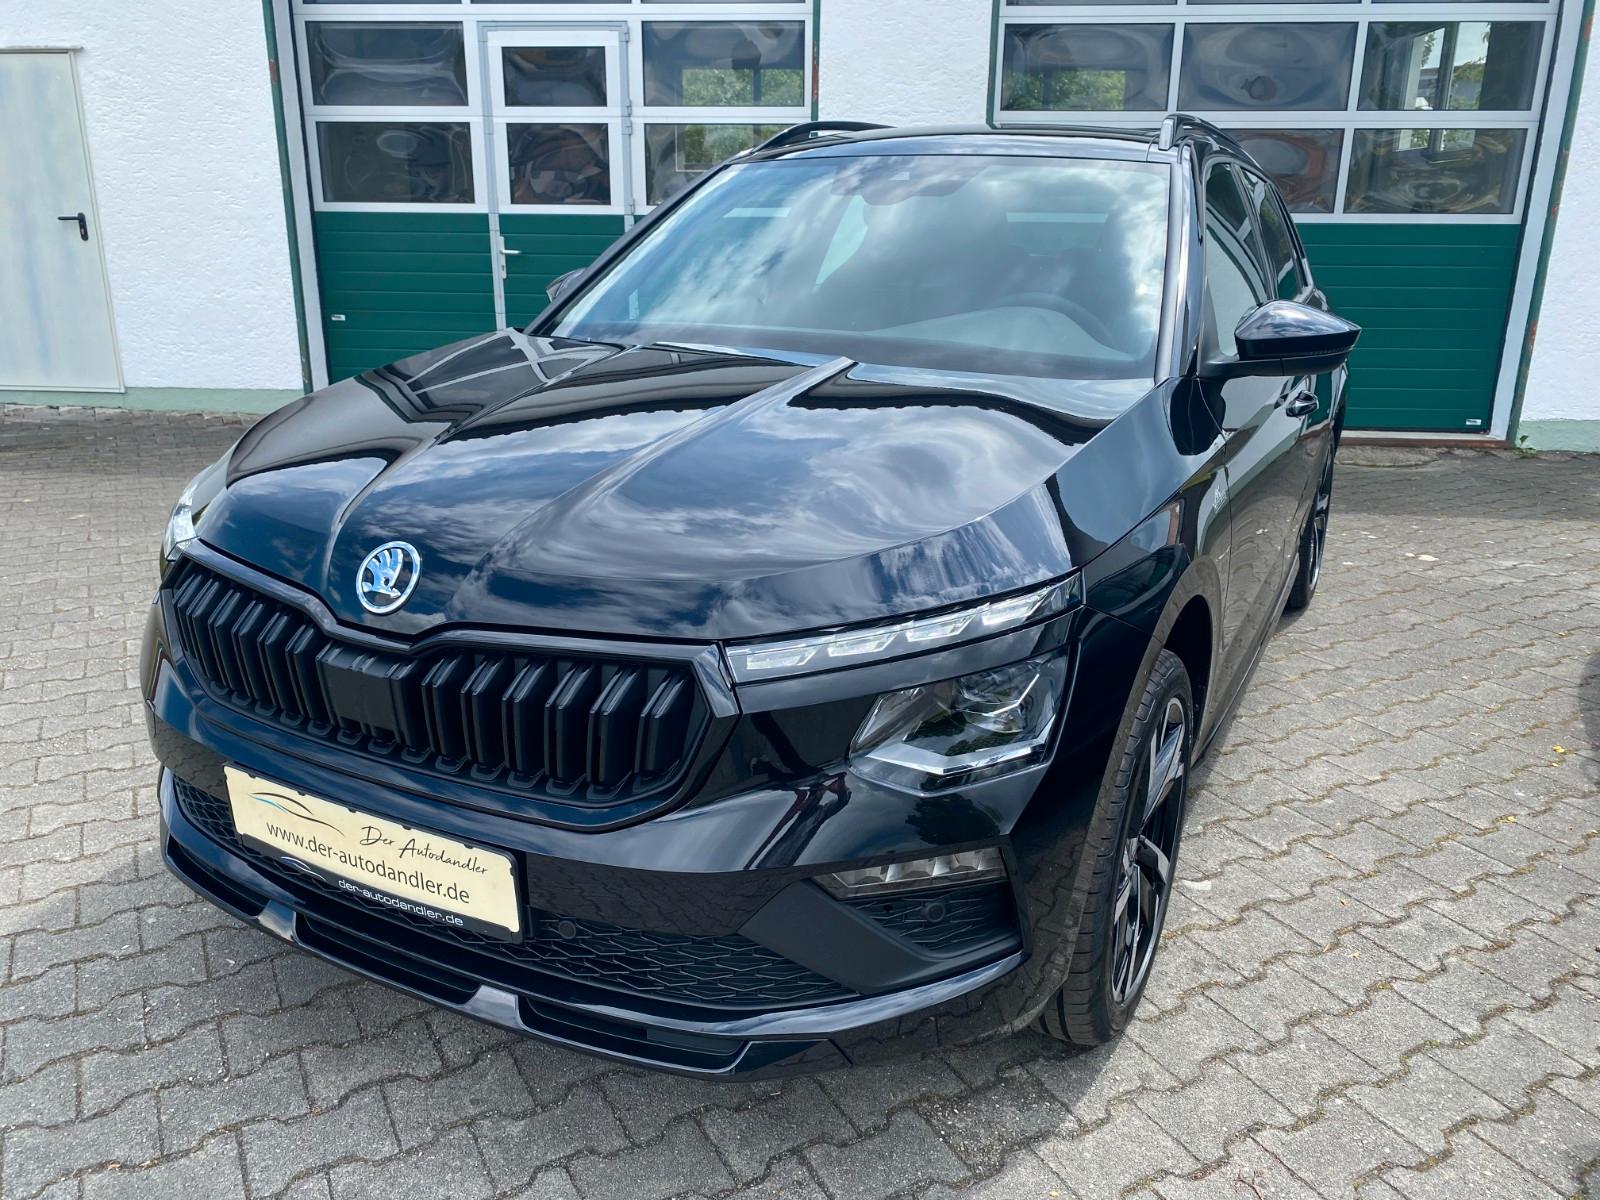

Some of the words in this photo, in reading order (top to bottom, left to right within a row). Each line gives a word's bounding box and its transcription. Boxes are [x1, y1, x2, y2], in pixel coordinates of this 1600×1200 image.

[266, 821, 470, 904] www.der-autodandler.de
[359, 825, 396, 846] Der
[398, 838, 488, 875] Autodandler
[338, 879, 464, 926] der-autodandler.de
